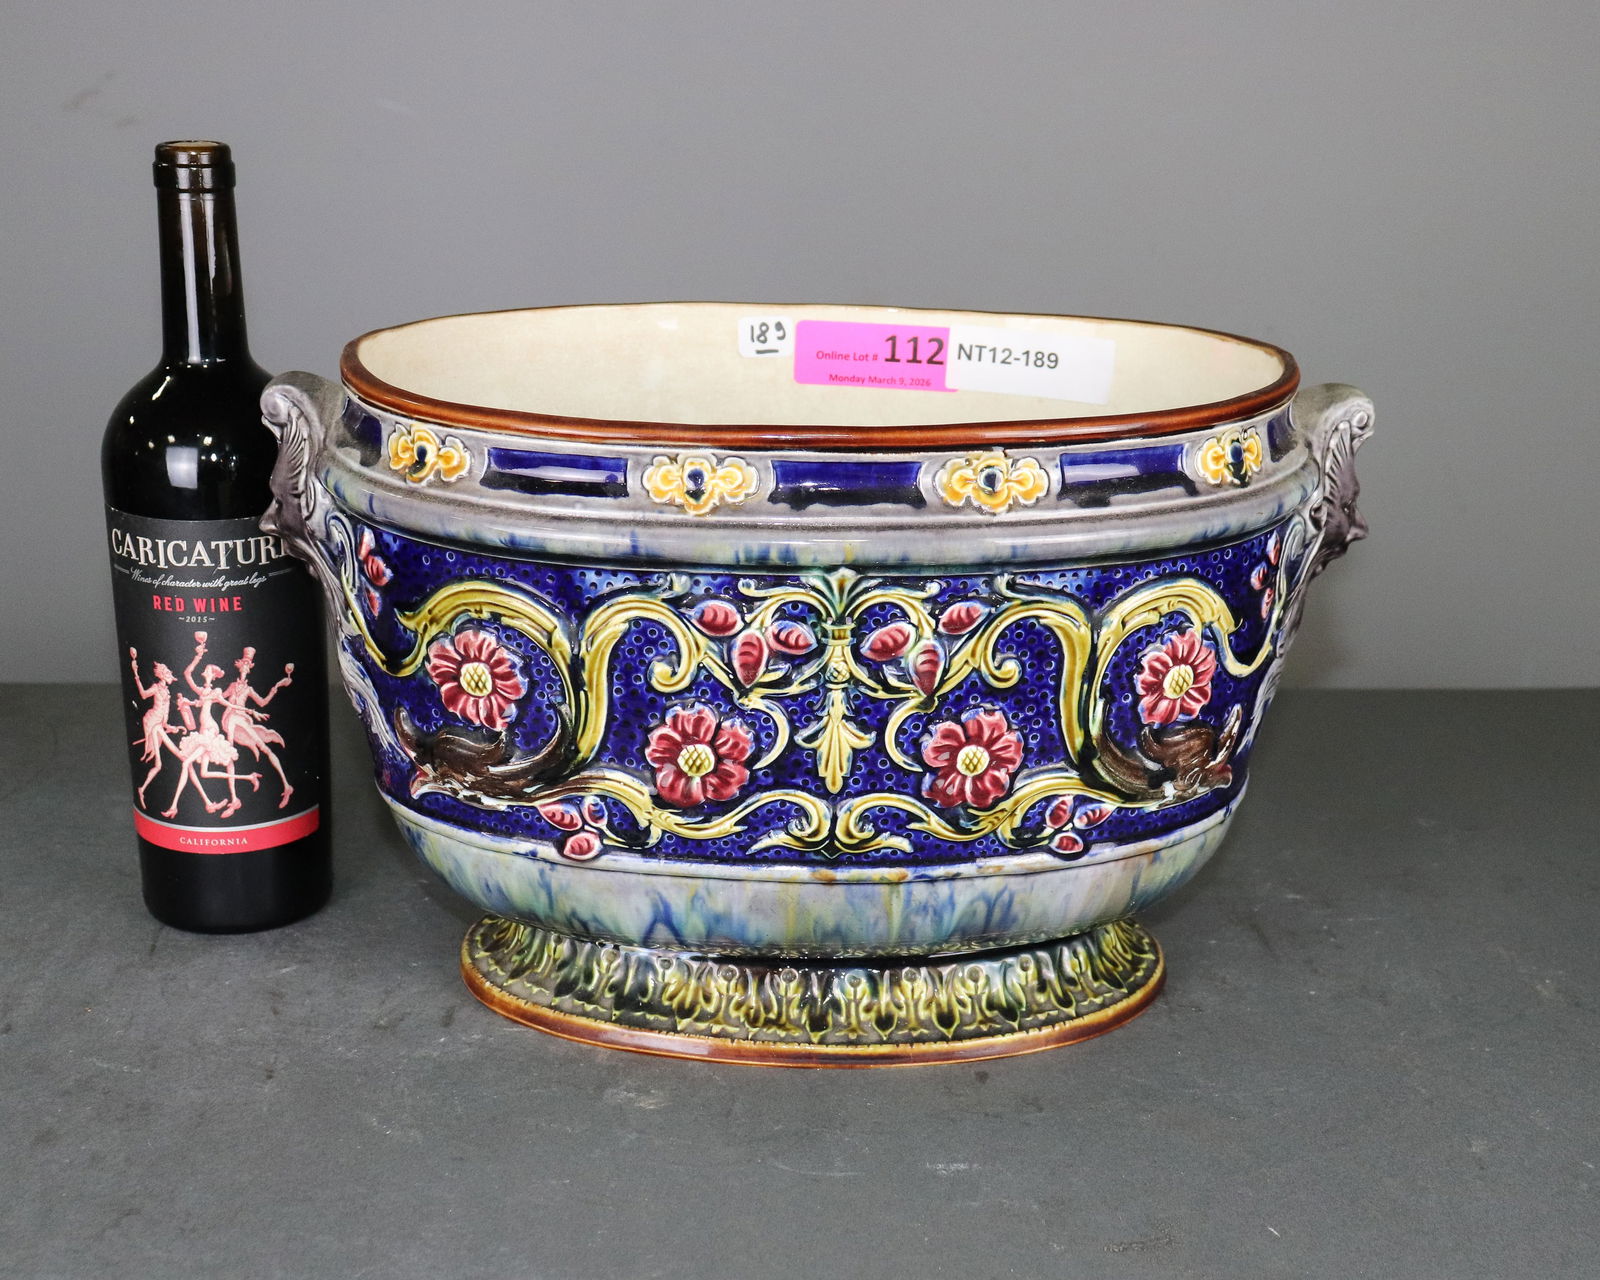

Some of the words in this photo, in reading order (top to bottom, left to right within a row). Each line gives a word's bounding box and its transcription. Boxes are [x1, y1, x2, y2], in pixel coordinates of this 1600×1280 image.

[750, 321, 786, 344] 189
[816, 350, 850, 361] Online
[853, 352, 869, 361] Lot
[872, 353, 878, 361] #
[884, 335, 944, 365] 112
[957, 343, 1059, 369] NT12-189
[829, 374, 865, 384] Monday
[868, 376, 897, 384] March
[898, 377, 907, 386] 9,
[909, 378, 932, 387] 2026
[130, 566, 152, 584] Wines
[152, 573, 165, 589] of
[161, 574, 202, 588] character
[202, 575, 225, 587] with
[221, 576, 248, 591] great
[248, 571, 267, 588] legs
[152, 594, 185, 612] RED
[192, 596, 243, 613] WINE
[179, 836, 248, 847] CALIFORNIA
